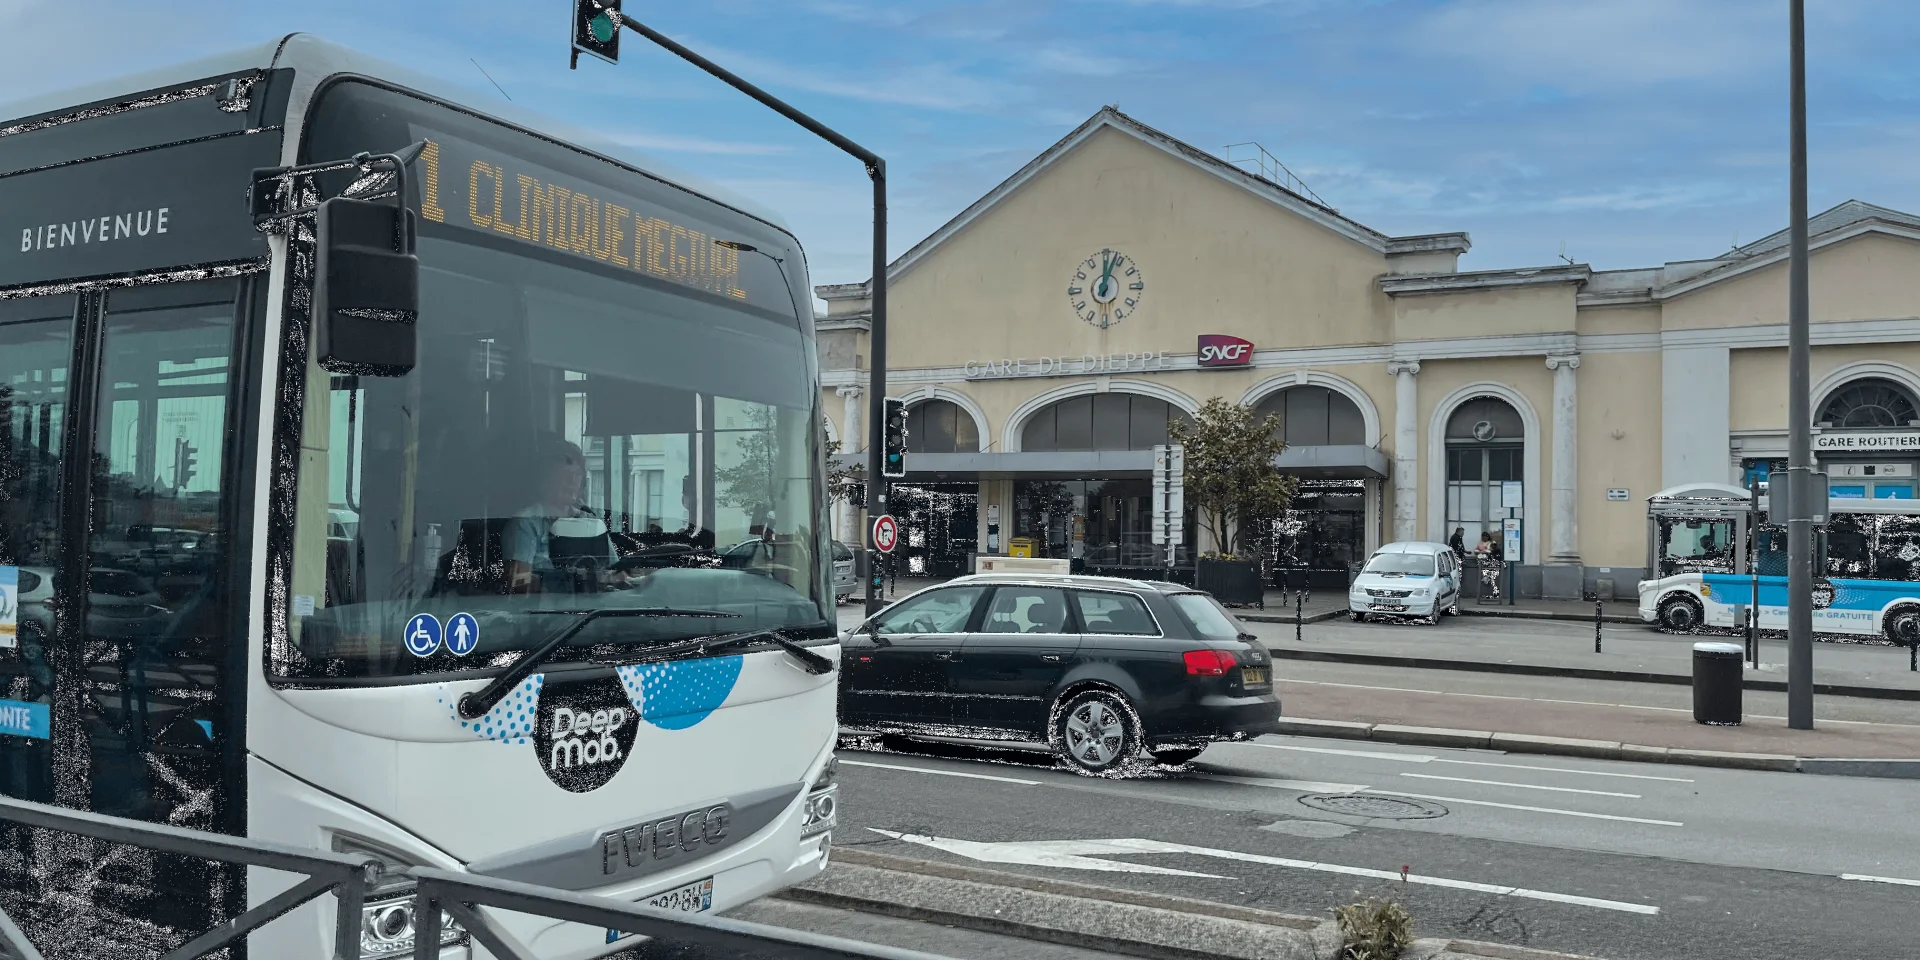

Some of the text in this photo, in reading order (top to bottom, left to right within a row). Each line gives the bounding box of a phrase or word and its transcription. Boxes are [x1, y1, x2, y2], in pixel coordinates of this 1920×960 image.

[420, 141, 444, 223] 1
[469, 160, 630, 268] CLINIQUE
[21, 207, 169, 252] BIENVENUE
[964, 350, 1171, 378] GARE DE DIEPPE
[1199, 344, 1250, 362] SNCF
[1818, 436, 1920, 447] GARE ROUTIER
[1824, 612, 1873, 621] GRATUITE
[551, 707, 626, 740] Deep
[603, 805, 730, 875] IVECO
